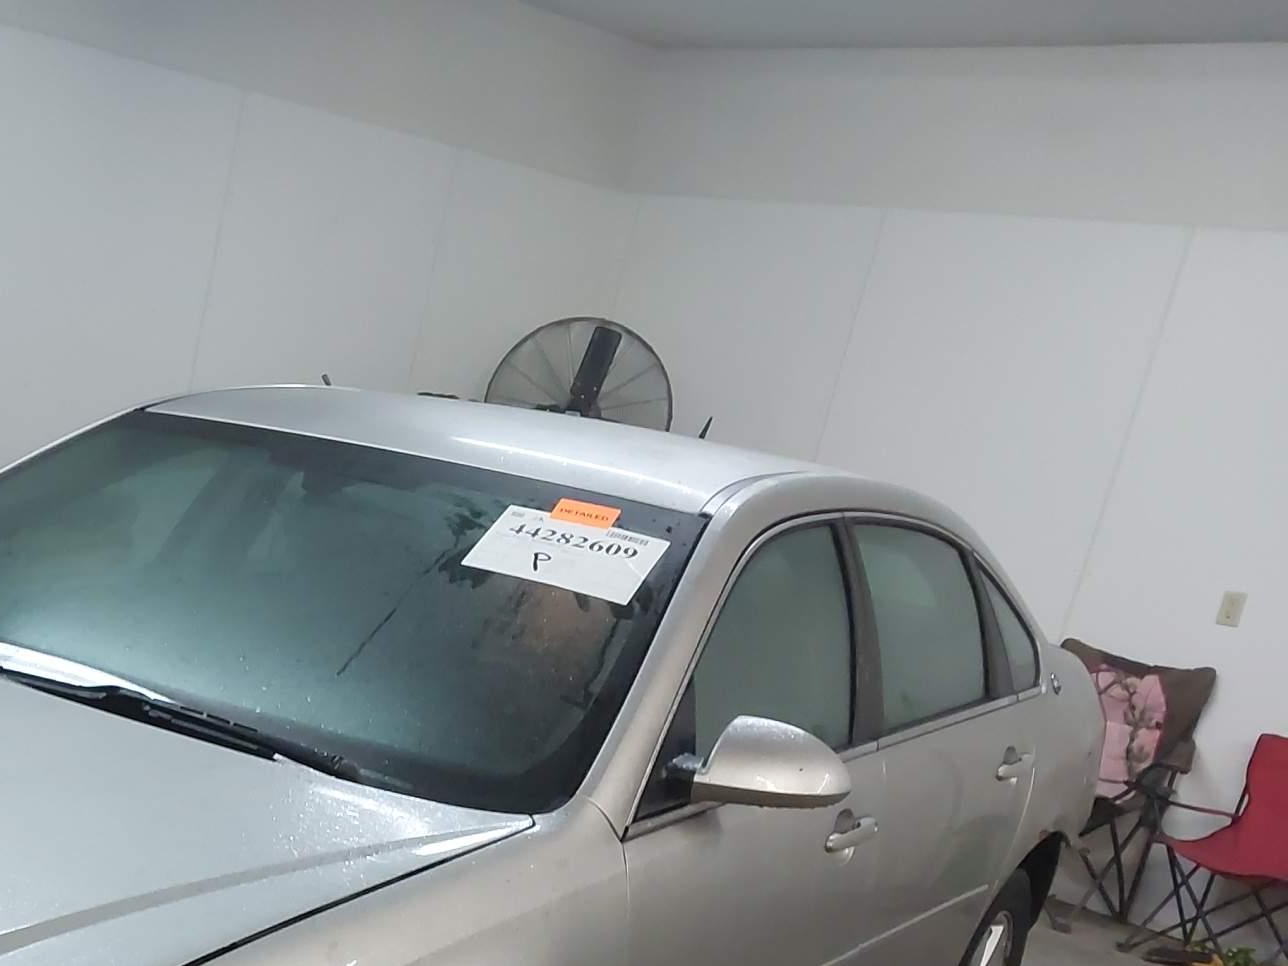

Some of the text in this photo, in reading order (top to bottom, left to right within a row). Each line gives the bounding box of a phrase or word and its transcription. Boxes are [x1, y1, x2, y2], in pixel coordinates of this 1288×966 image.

[559, 507, 610, 522] DETAILED
[509, 522, 639, 560] 44282609
[532, 551, 552, 572] P
